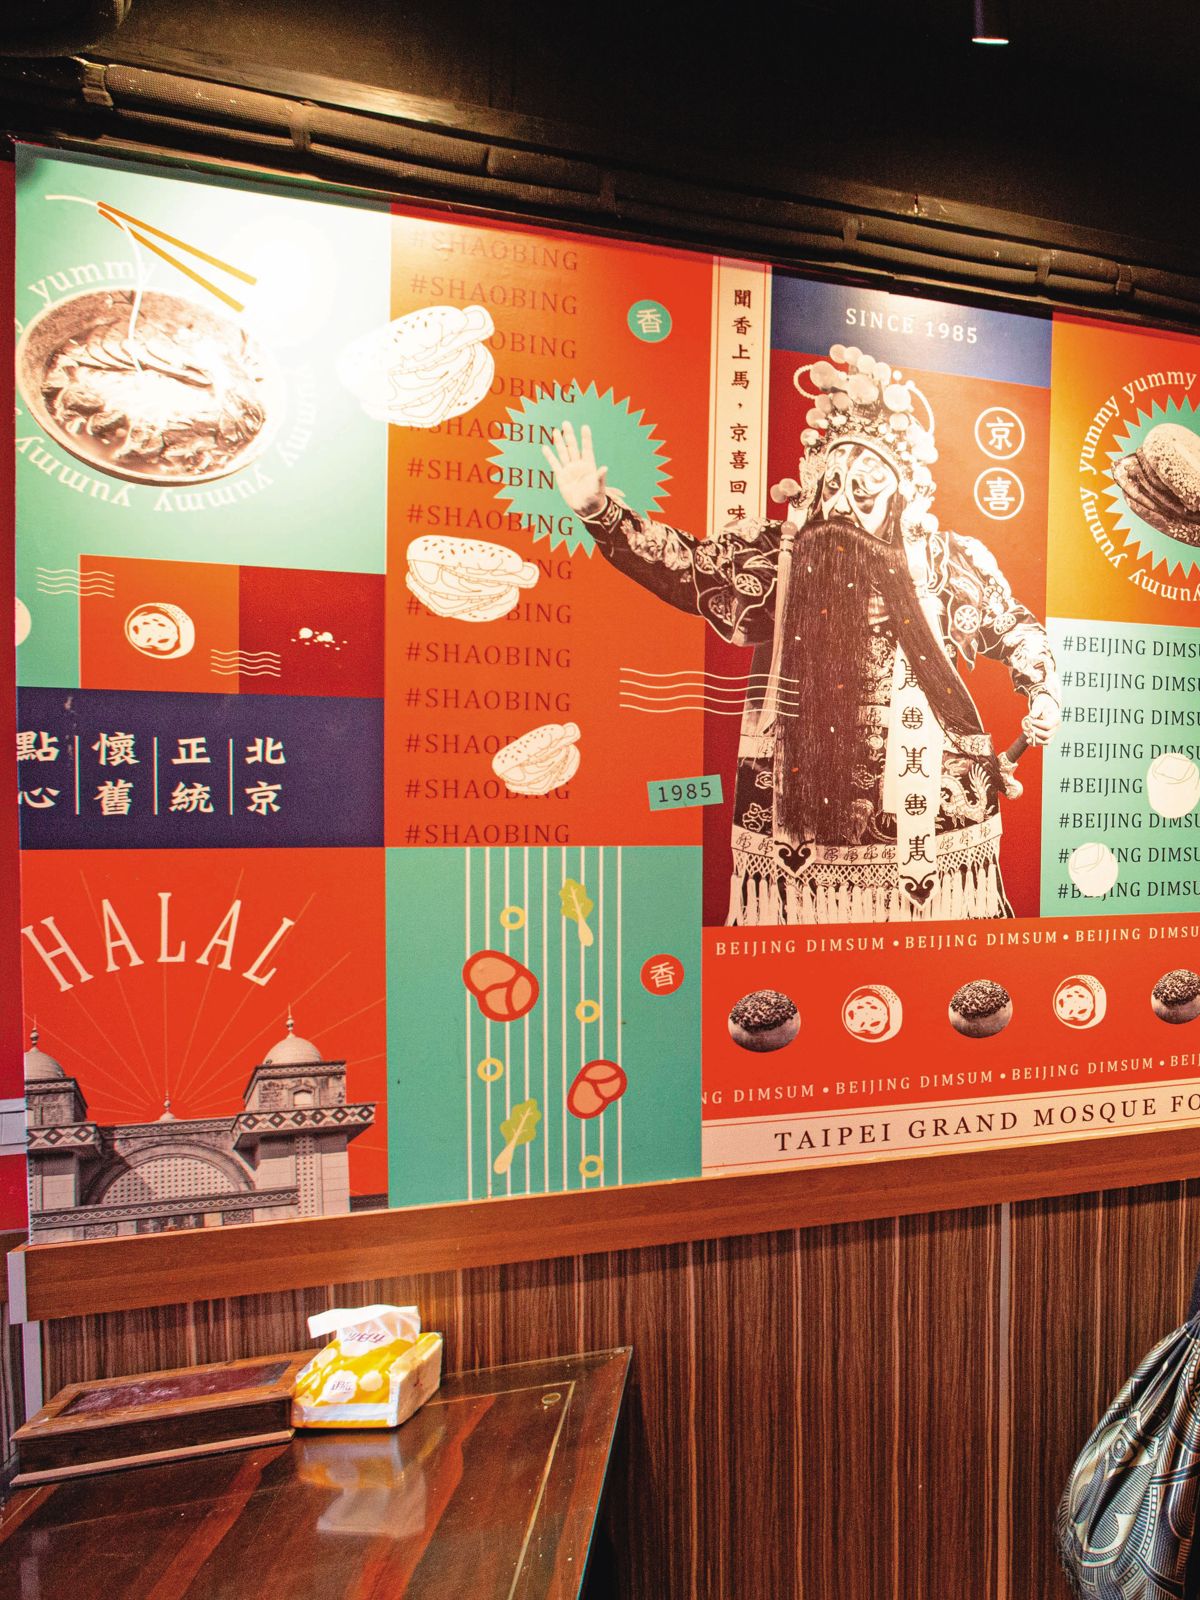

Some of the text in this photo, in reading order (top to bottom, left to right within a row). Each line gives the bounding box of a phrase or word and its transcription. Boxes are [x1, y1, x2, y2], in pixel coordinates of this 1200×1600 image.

[410, 273, 577, 315] #SHAOBING
[636, 308, 664, 334] 香
[845, 308, 978, 344] SINCE 1985
[489, 331, 577, 359] OBING
[489, 376, 576, 403] OBING
[1122, 371, 1197, 403] yummy
[1079, 395, 1121, 475] yummy
[16, 435, 138, 508] yummy
[407, 457, 555, 490] #SHAOBIN
[154, 467, 273, 512] yummy
[406, 503, 574, 536] #SHAOBING
[1079, 487, 1128, 568] yummy
[406, 595, 572, 624] #BING
[405, 642, 572, 668] #SHAOBING
[1063, 636, 1146, 657] #BEIJING
[1062, 671, 1145, 692] #BEIJING
[405, 688, 571, 713] #SHAOBING
[1061, 707, 1144, 727] #BEIJING
[405, 733, 519, 755] #SHAO
[1060, 742, 1143, 762] #BEIJING
[657, 781, 712, 803] 1985
[1060, 777, 1143, 797] #BEIJING
[405, 823, 569, 844] #SHAOBING
[1059, 813, 1142, 832] #BEIJING
[20, 892, 295, 992] HALAL
[716, 940, 796, 957] BEIJING
[806, 937, 885, 953] DIMSUM
[905, 934, 977, 953] BEIJING
[986, 930, 1057, 946] DIMSUM
[1075, 928, 1141, 943] BEIJING
[649, 962, 675, 988] 香
[734, 1084, 815, 1103] DIMSUM
[835, 1077, 910, 1095] BEIJING
[920, 1071, 993, 1088] DIMSUM
[1012, 1064, 1080, 1082] BEIJING
[1088, 1058, 1153, 1074] DIMSUM
[774, 1123, 892, 1151] TAIPEI
[909, 1112, 1017, 1140] GRAND
[1034, 1098, 1157, 1126] MOSQUE
